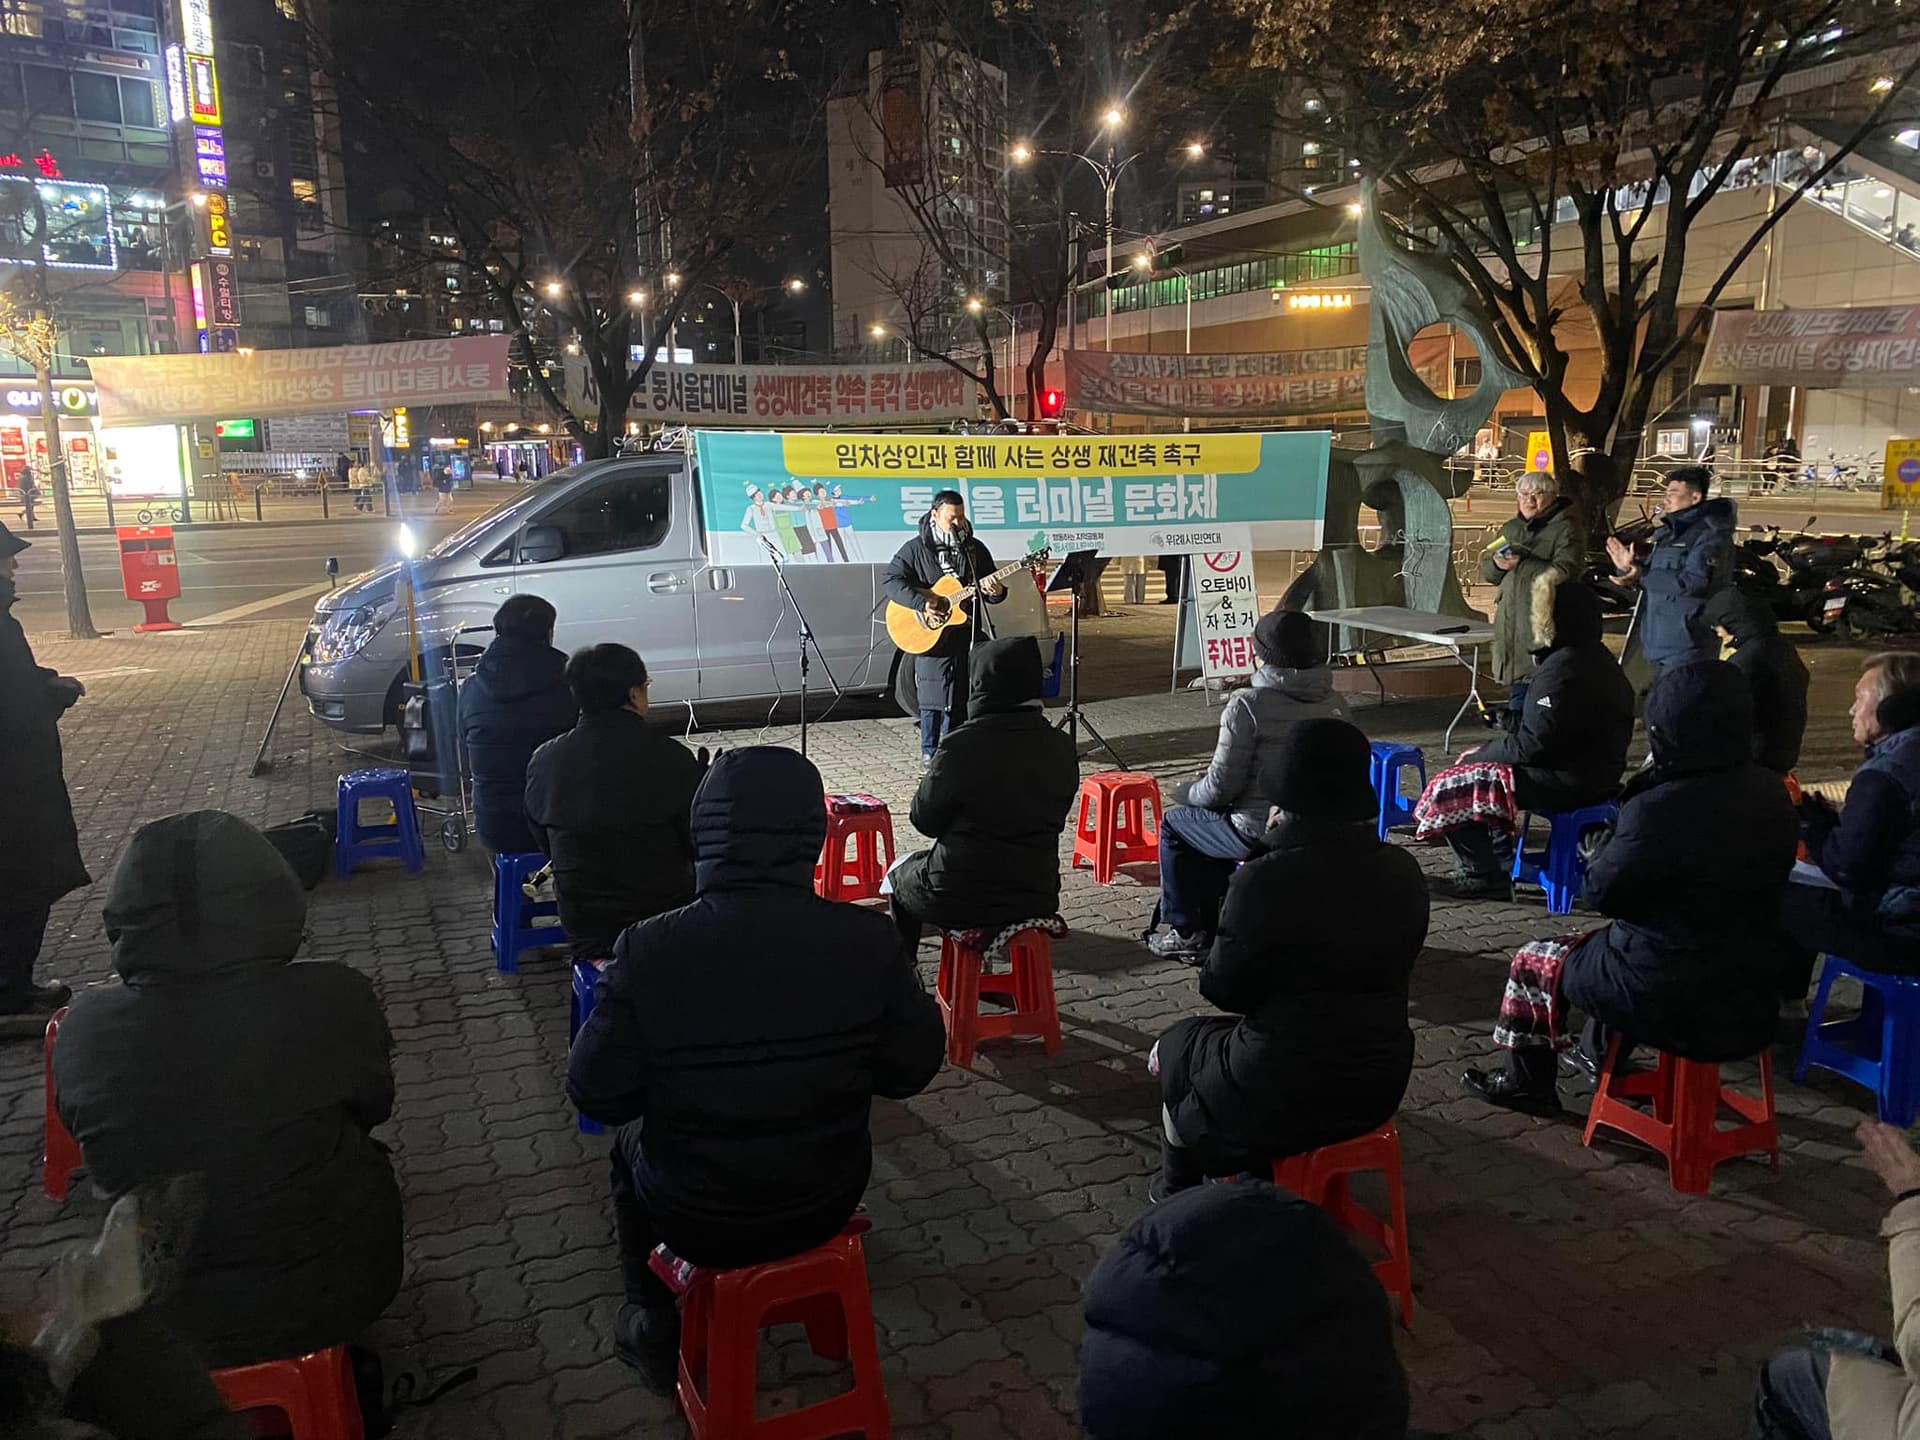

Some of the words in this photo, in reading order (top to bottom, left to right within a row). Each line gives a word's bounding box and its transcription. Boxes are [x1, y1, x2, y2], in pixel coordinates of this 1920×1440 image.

[652, 370, 748, 414] 동서울터미널
[753, 375, 832, 416] 상생재건축
[836, 374, 866, 413] 약속
[870, 372, 900, 412] 즉각
[904, 369, 964, 411] 실행하라
[836, 444, 948, 469] 임차상인과
[954, 444, 997, 469] 함께
[1004, 445, 1044, 469] 사는
[1051, 445, 1091, 469] 상생
[1098, 443, 1157, 468] 재건축
[1163, 443, 1201, 466] 촉구
[1016, 477, 1114, 523] 터미널
[1125, 473, 1218, 521] 문화제
[1166, 532, 1222, 547] 위례시민연대
[1200, 575, 1252, 593] 오토바이
[1221, 595, 1233, 609] &
